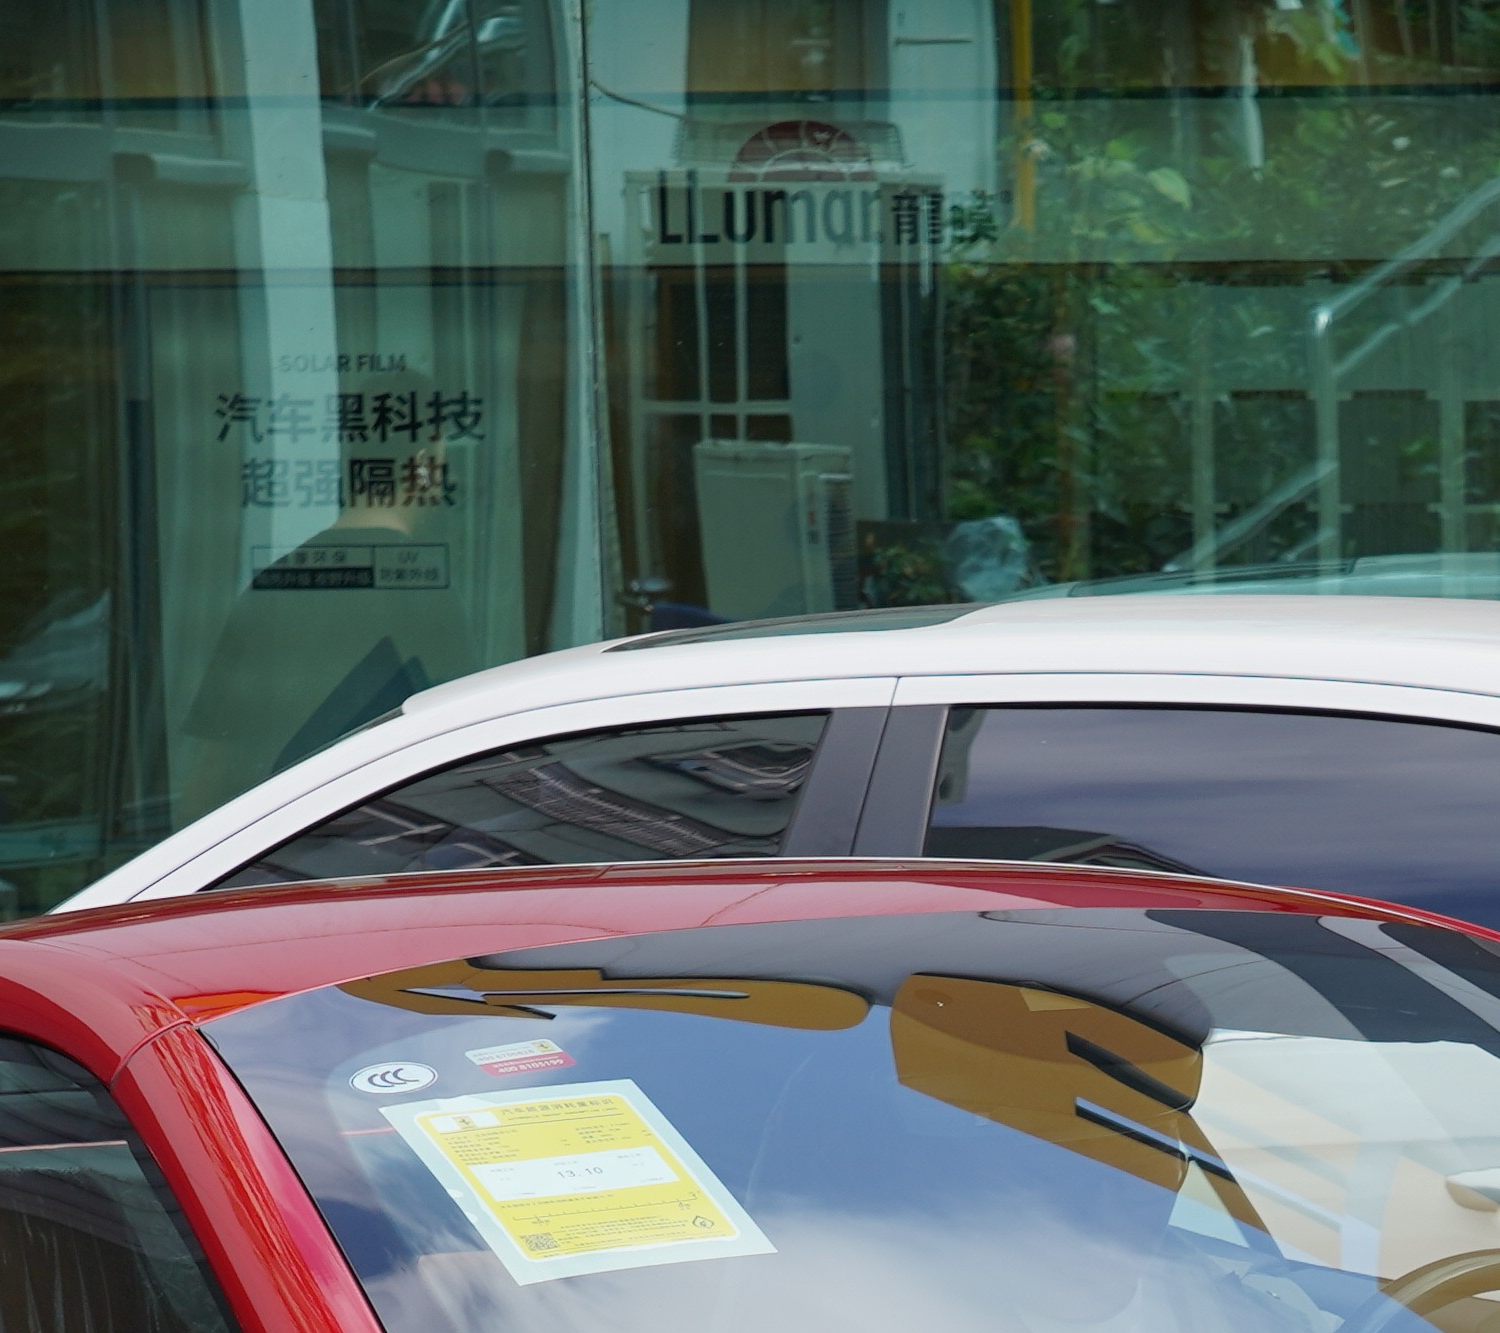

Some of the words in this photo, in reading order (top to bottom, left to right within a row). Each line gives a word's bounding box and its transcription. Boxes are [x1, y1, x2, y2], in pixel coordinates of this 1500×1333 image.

[278, 354, 350, 373] SOLAR
[356, 354, 407, 372] FILM
[215, 390, 486, 444] 汽车黑科技
[241, 456, 458, 509] 超强隔热
[367, 1067, 420, 1088] CCC
[557, 1166, 604, 1178] 13.10
